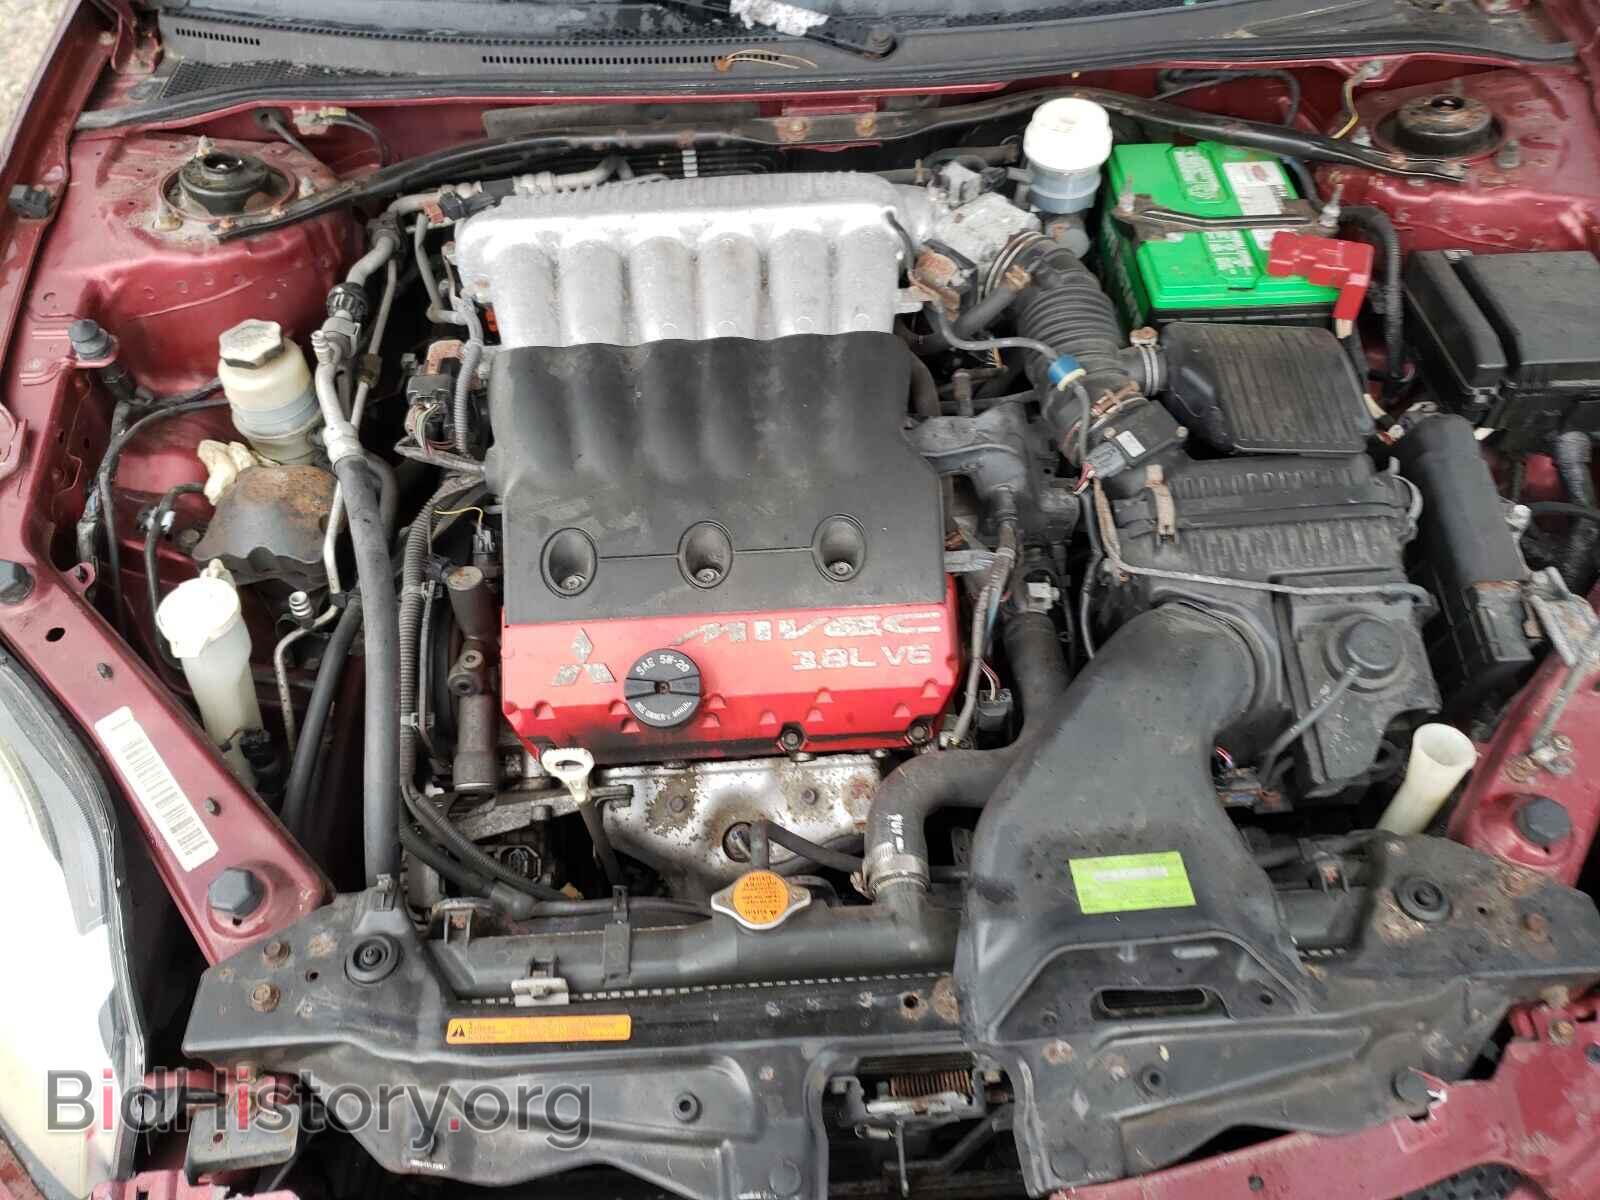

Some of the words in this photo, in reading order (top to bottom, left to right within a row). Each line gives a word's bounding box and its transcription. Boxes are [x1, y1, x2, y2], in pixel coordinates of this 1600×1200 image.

[635, 657, 656, 676] SAE
[792, 647, 877, 671] 3.8L
[881, 643, 932, 666] V6
